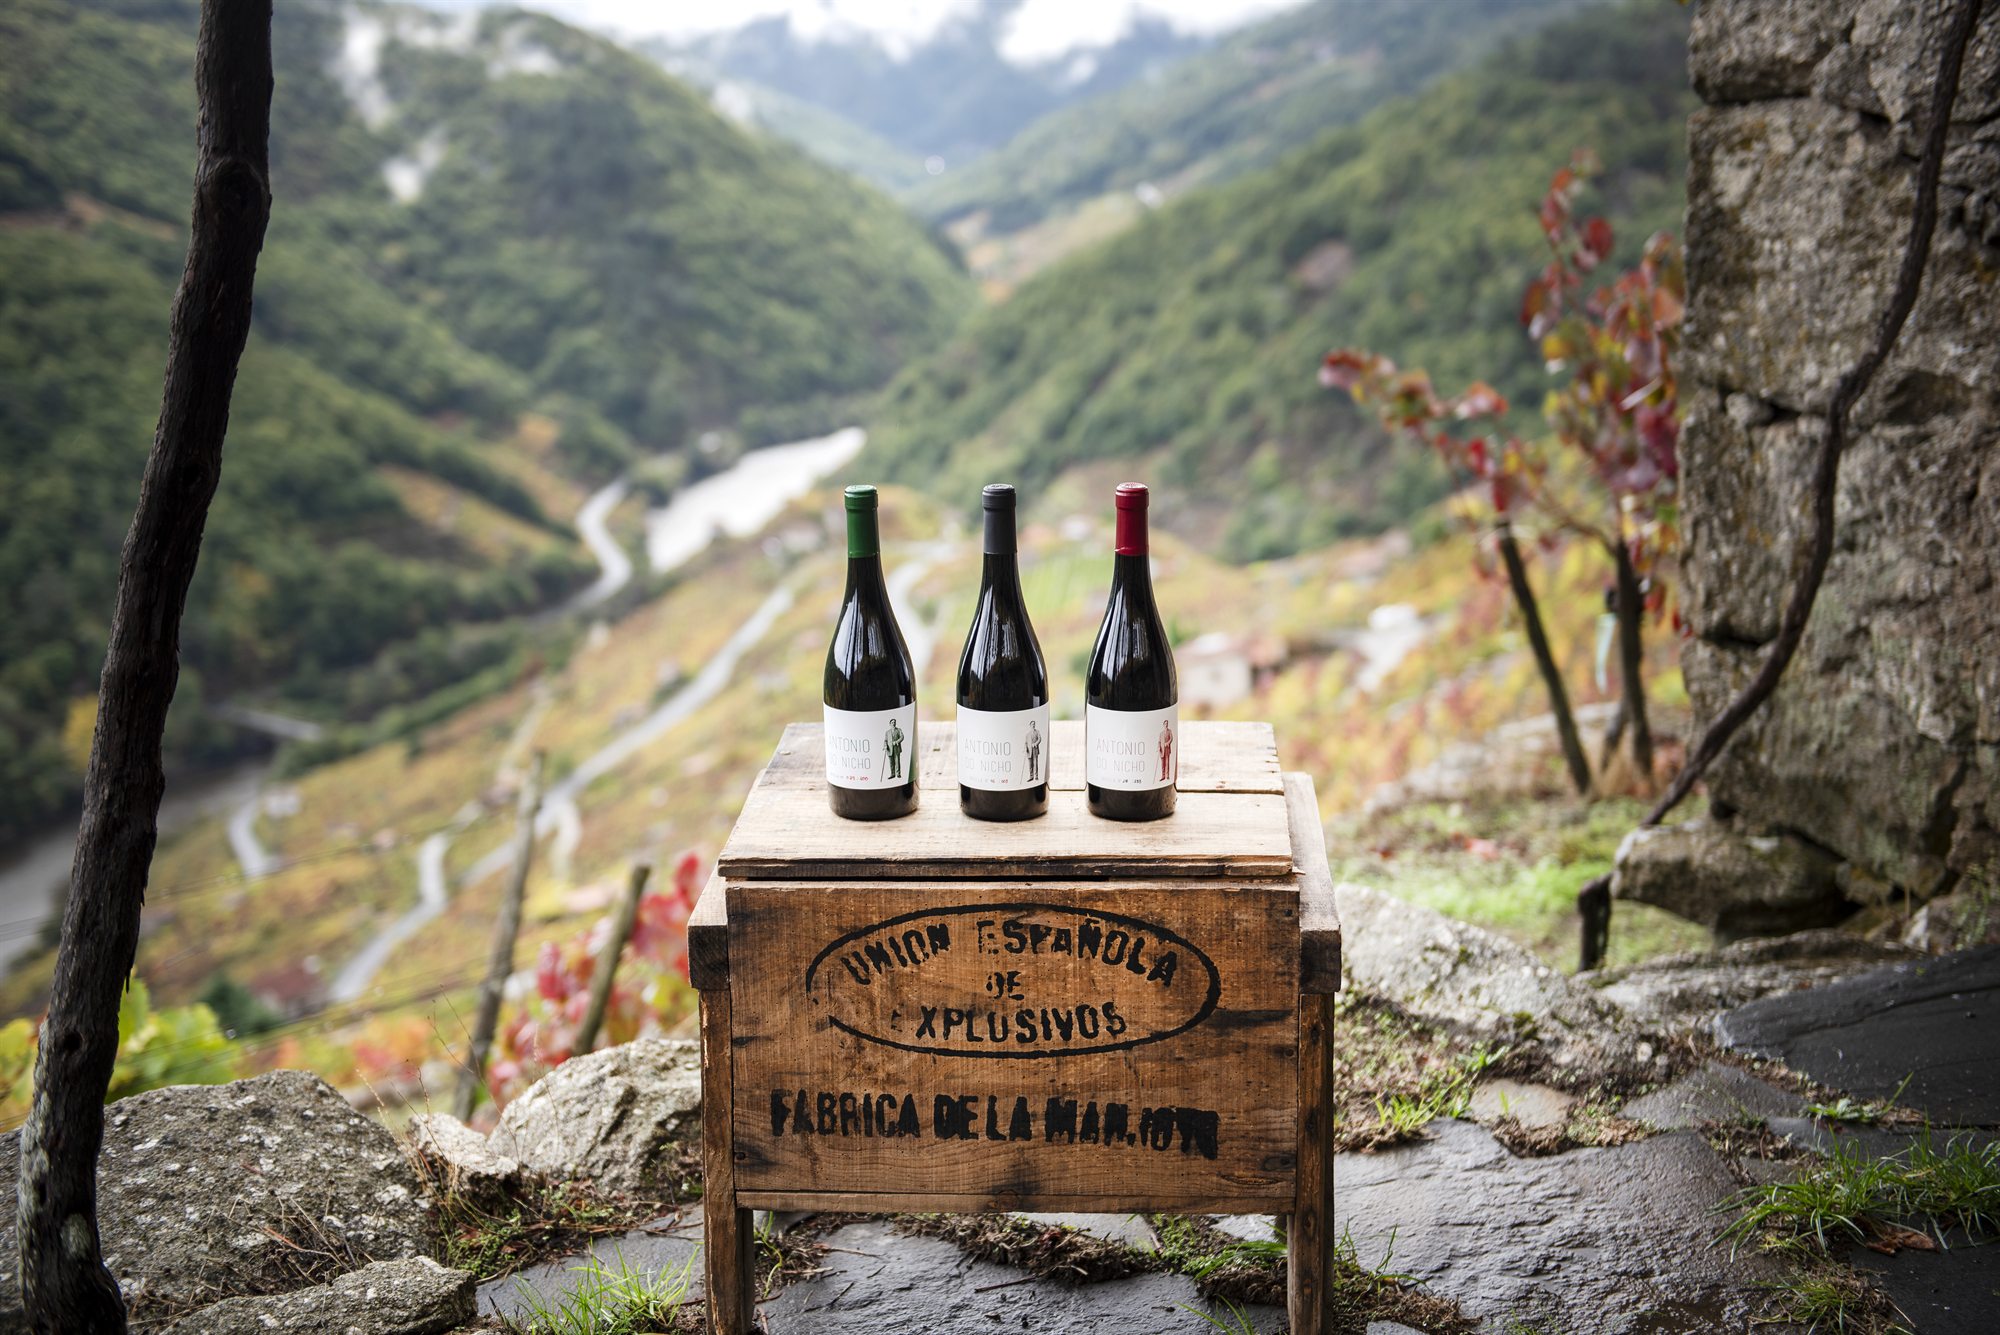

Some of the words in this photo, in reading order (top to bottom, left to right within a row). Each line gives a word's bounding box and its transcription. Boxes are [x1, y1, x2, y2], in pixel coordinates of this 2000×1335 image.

[964, 737, 1011, 756] ANTONIO
[1096, 738, 1145, 756] ANTONIO
[842, 755, 871, 770] NICHO
[980, 759, 1012, 773] NICHO
[1113, 759, 1145, 773] NICHO
[840, 923, 951, 986] UNION
[976, 918, 1177, 988] ESPAÑOLA
[985, 970, 1025, 1001] DE
[770, 1087, 921, 1138] FABRICA
